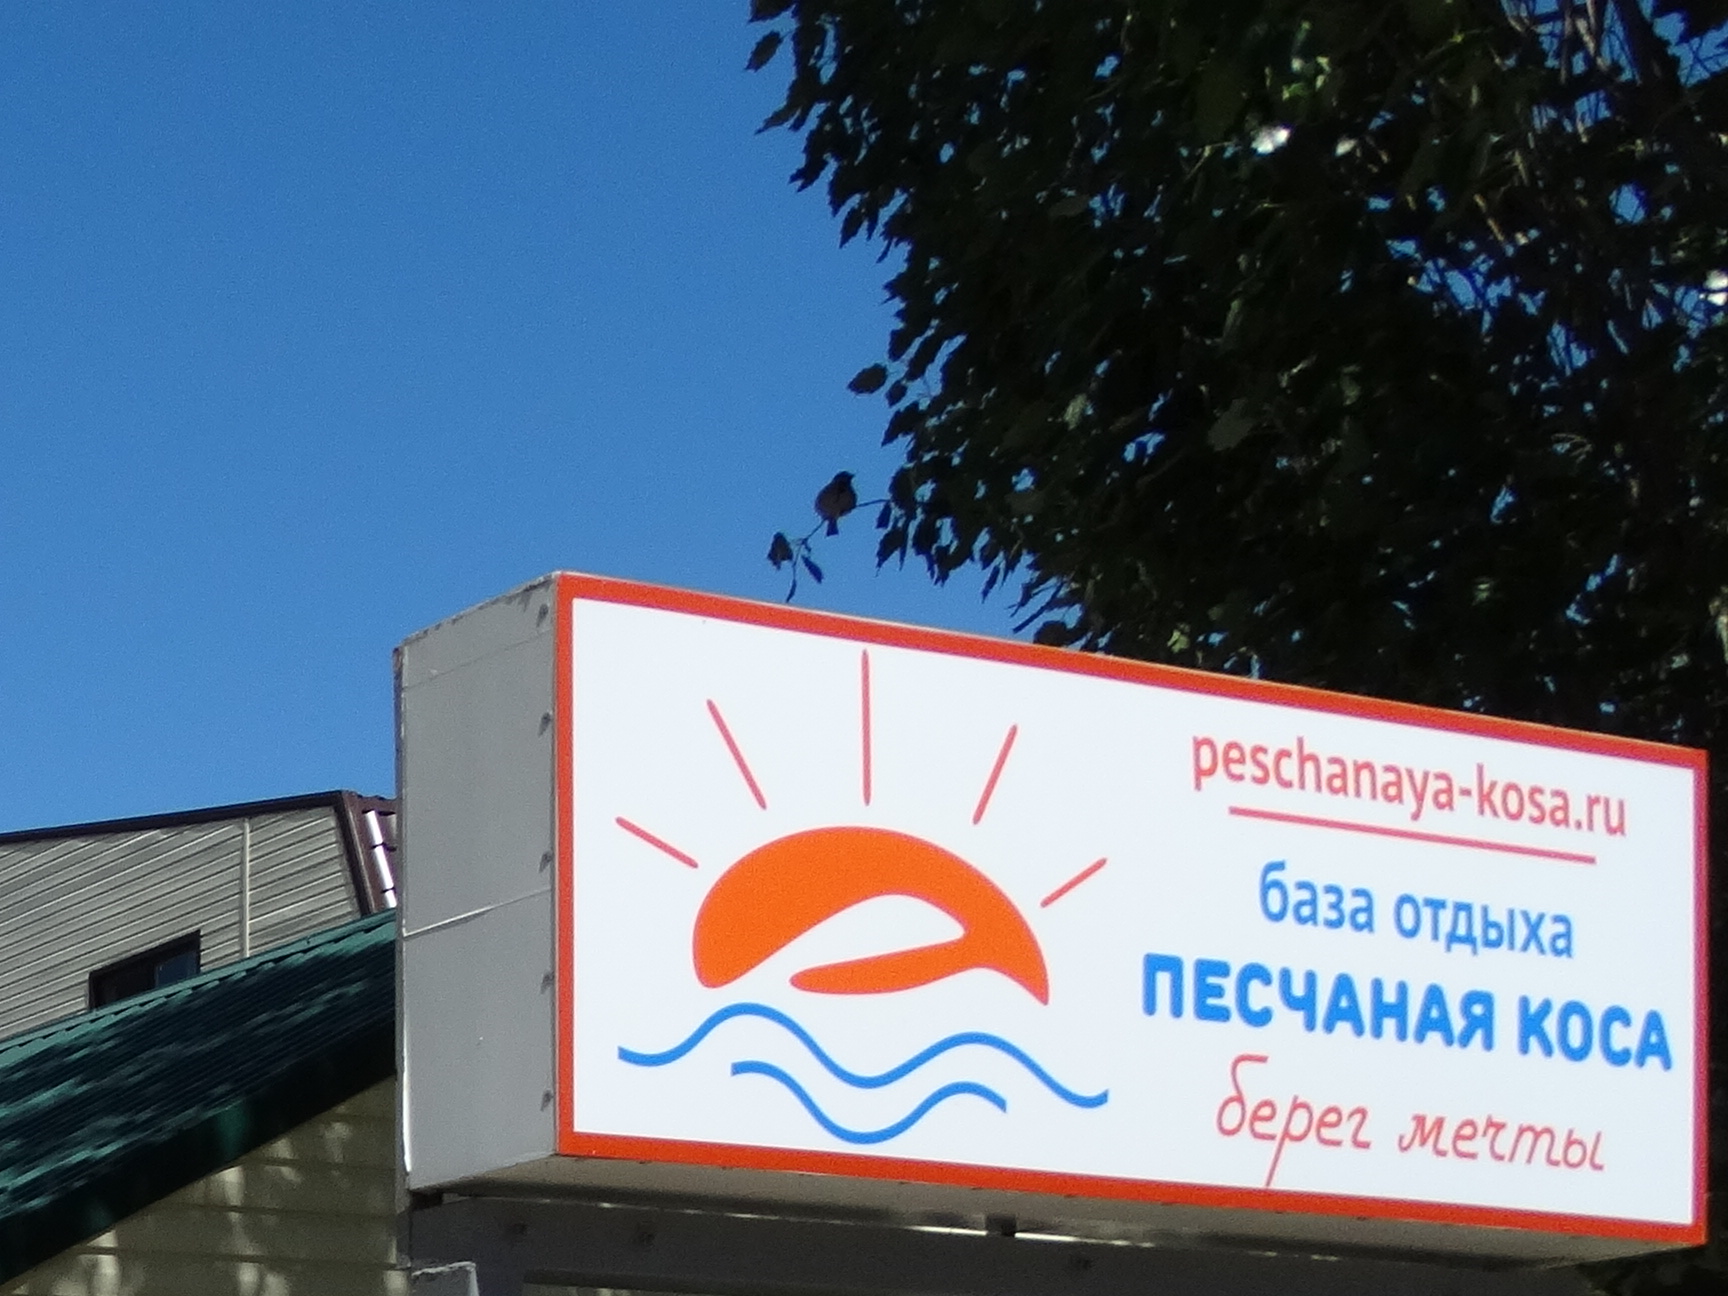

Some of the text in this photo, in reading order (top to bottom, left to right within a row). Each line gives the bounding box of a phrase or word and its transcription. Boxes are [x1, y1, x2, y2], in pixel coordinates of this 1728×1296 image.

[1192, 735, 1626, 837] peschanaya-kosa.ru
[1259, 859, 1574, 959] база отдыха
[1142, 952, 1673, 1071] ПЕСЧАНАЯ КОСА
[1216, 1053, 1605, 1188] берег мечты
